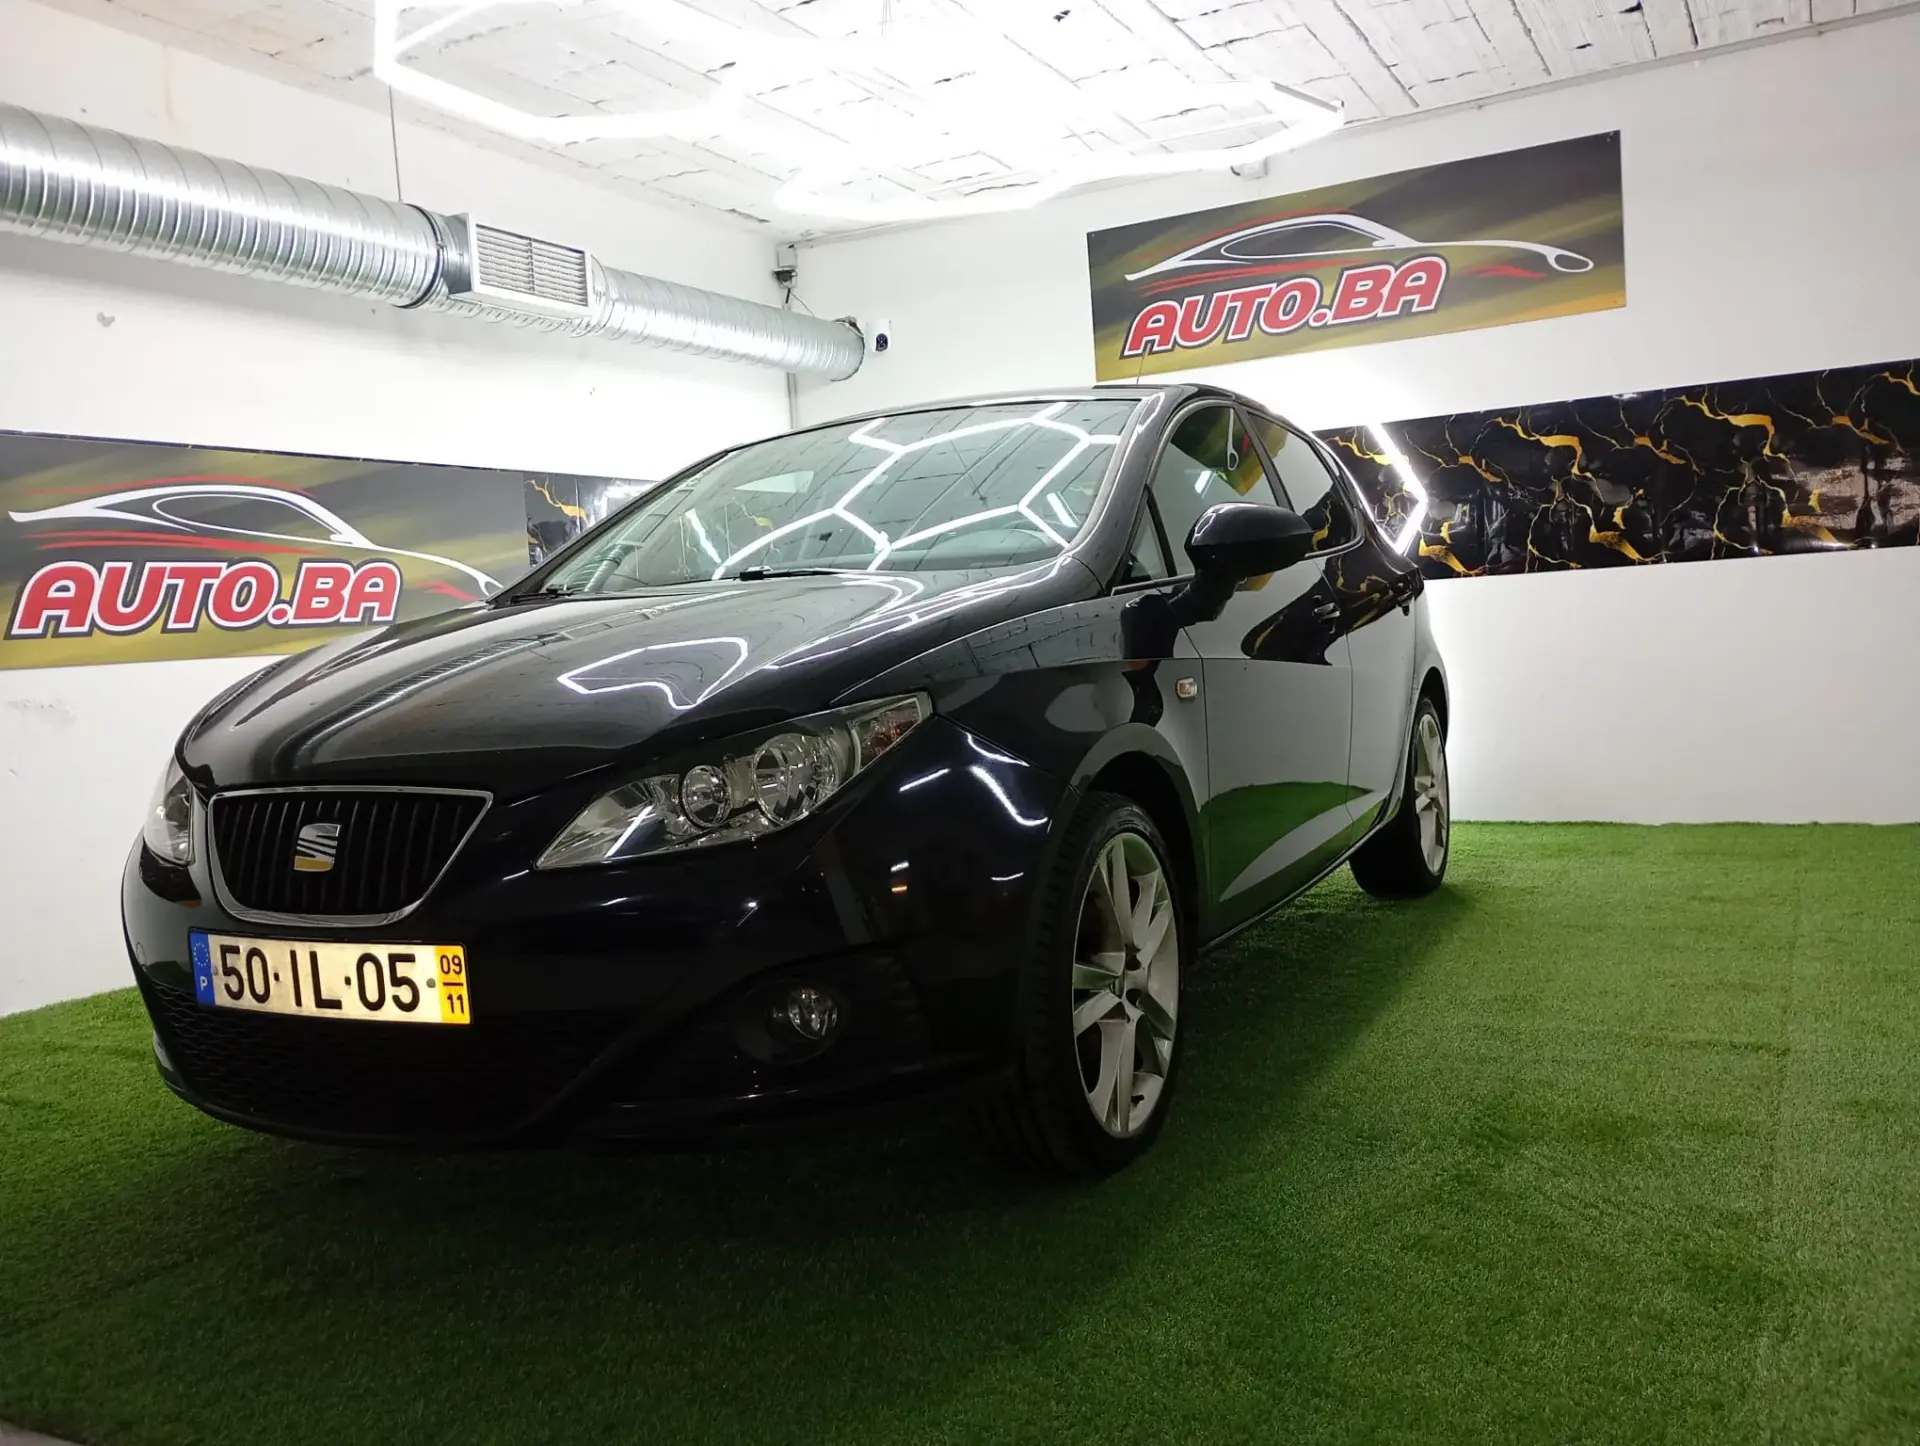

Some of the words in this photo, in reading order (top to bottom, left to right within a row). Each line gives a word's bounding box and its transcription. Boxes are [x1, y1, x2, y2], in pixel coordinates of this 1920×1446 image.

[1122, 256, 1448, 356] AUTO.BA
[10, 561, 401, 635] AUTO.BA
[440, 954, 463, 975] 09
[199, 975, 208, 991] P
[446, 993, 465, 1015] 11
